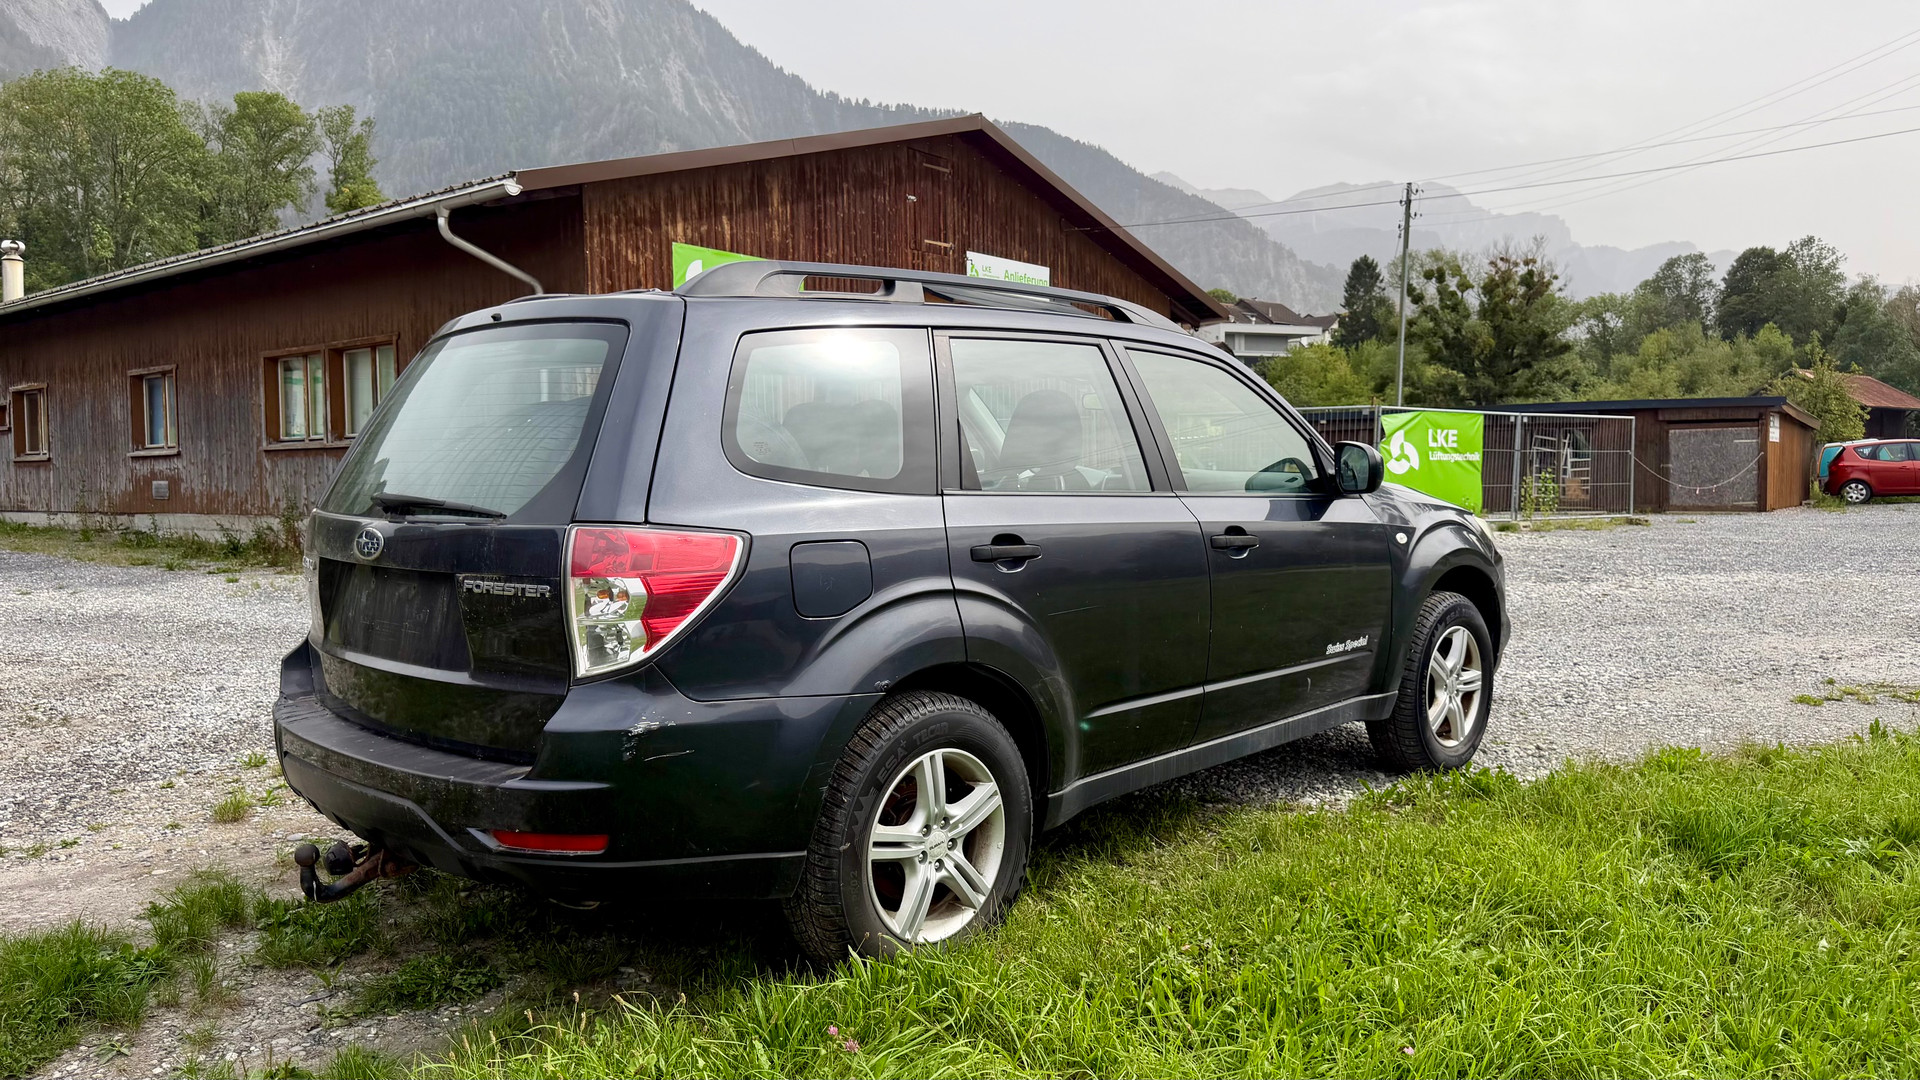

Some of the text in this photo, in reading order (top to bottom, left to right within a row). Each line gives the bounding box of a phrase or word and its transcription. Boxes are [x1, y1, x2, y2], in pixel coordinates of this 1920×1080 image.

[982, 264, 992, 273] LKE
[1428, 428, 1458, 447] LKE
[1429, 451, 1480, 462] Lüftungstechnik
[463, 580, 550, 597] FORESTER
[1345, 635, 1369, 651] Special
